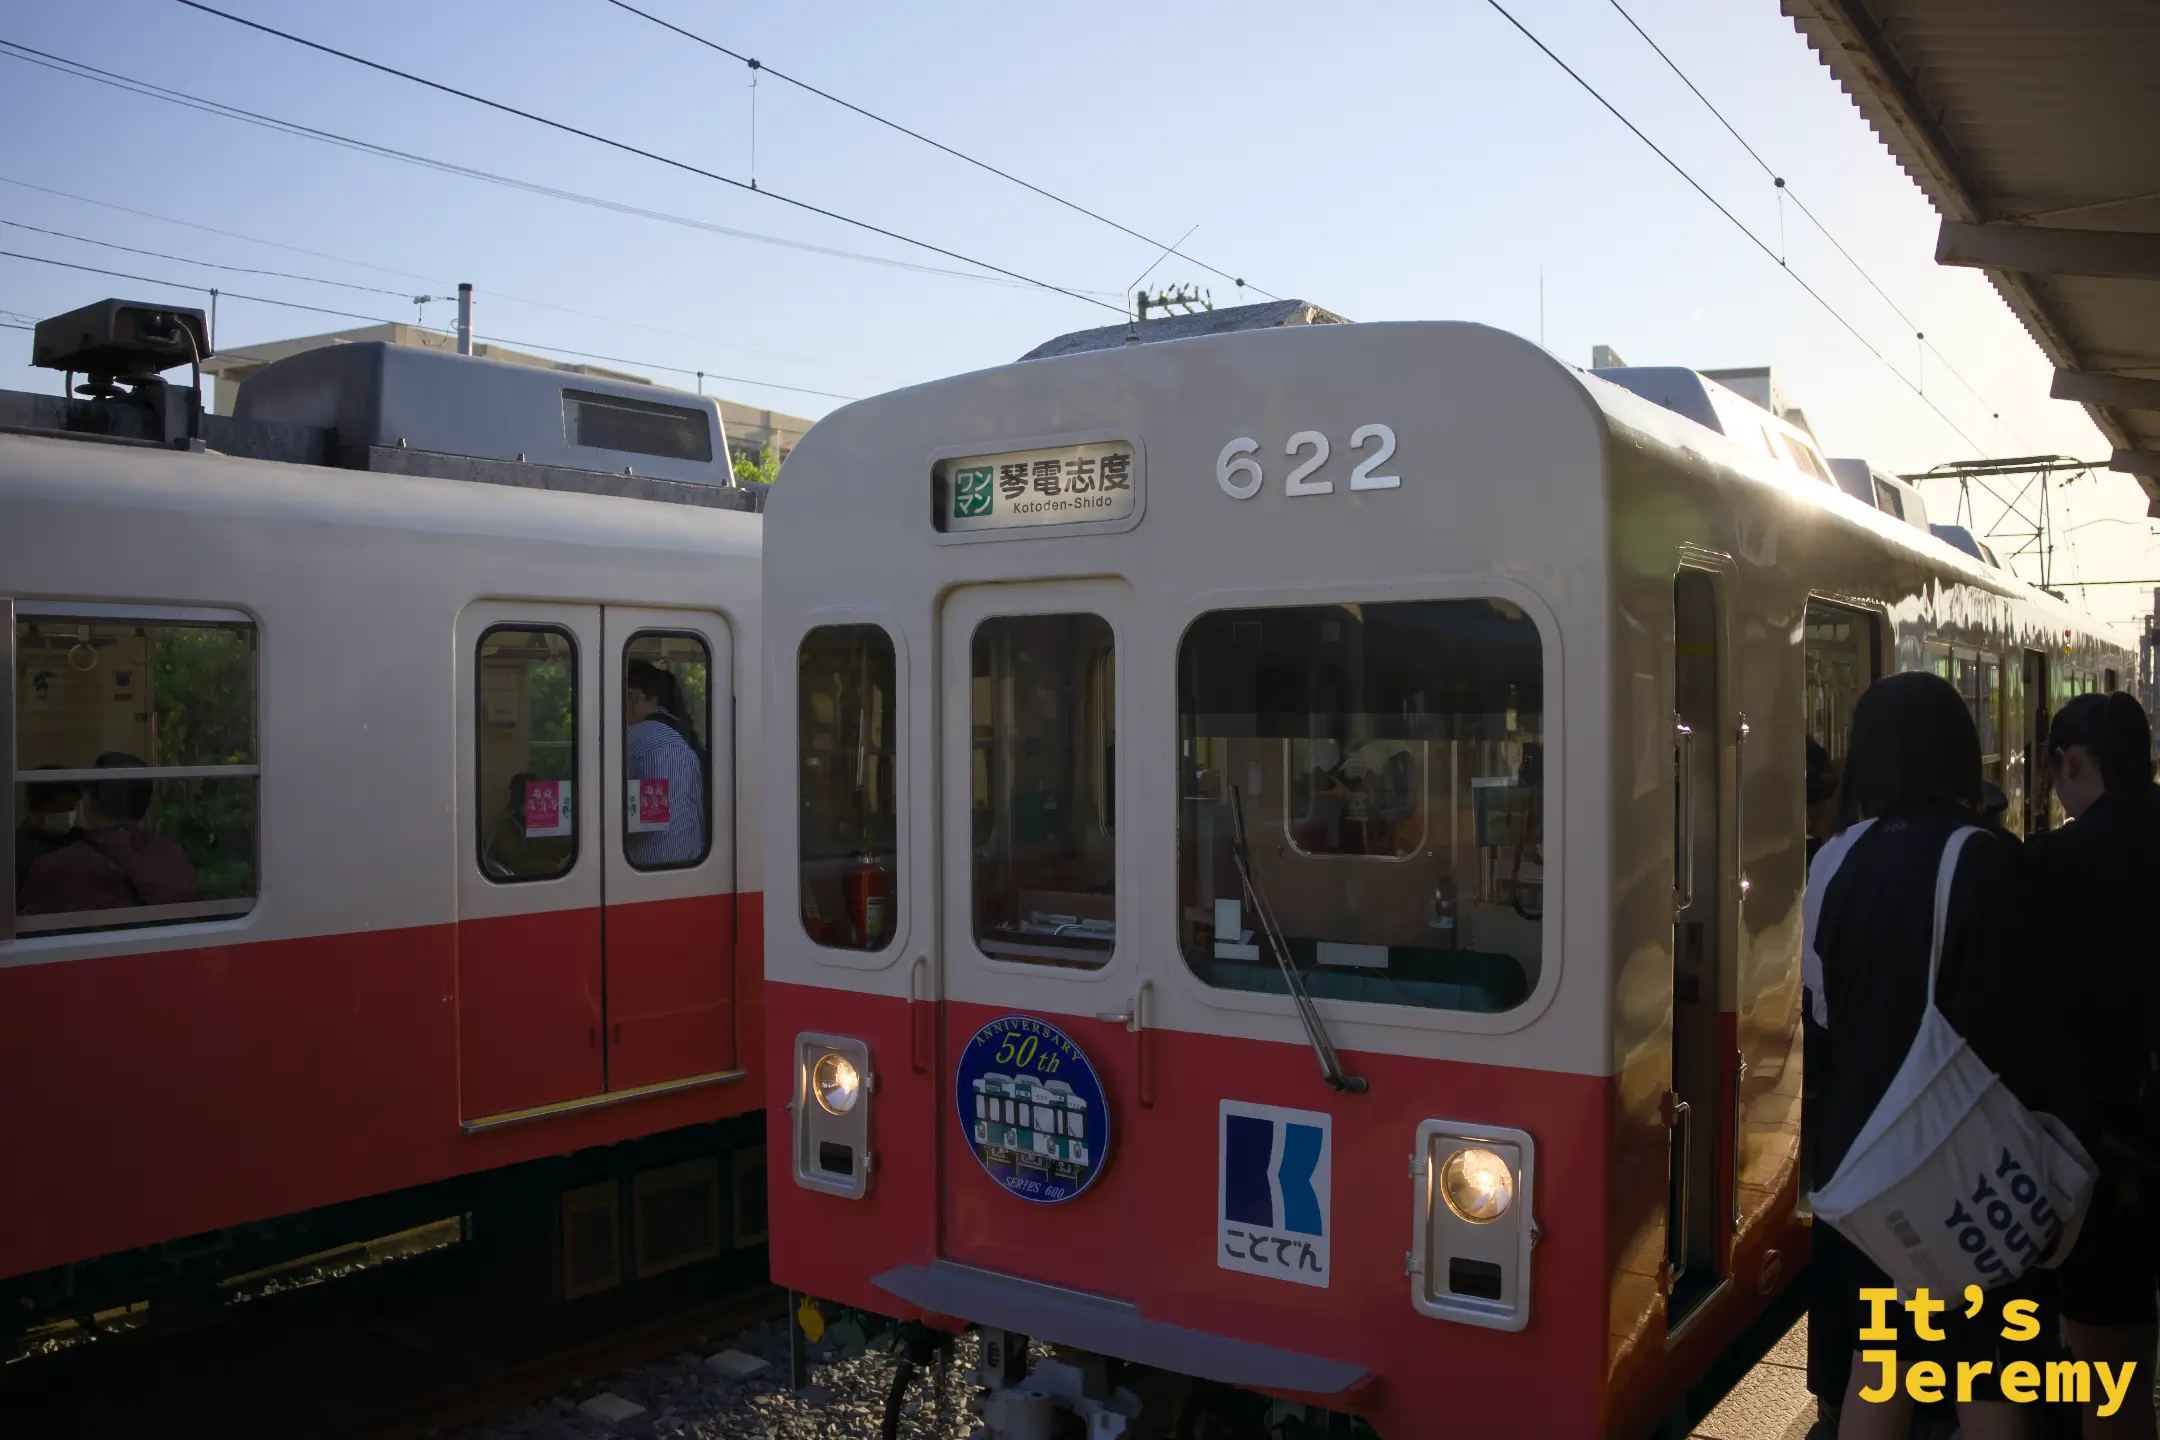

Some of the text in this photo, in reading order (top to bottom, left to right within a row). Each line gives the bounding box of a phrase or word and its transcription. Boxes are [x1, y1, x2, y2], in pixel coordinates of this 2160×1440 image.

[1000, 453, 1131, 500] 琴電志度
[1216, 423, 1401, 500] 622
[957, 470, 991, 493] ワン
[957, 493, 991, 514] マン
[1013, 496, 1112, 514] Kotoden-Shido
[975, 1019, 1082, 1062] ANNIVERSARY
[1003, 1176, 1065, 1199] SERIES 600
[1225, 1229, 1323, 1273] ことでん
